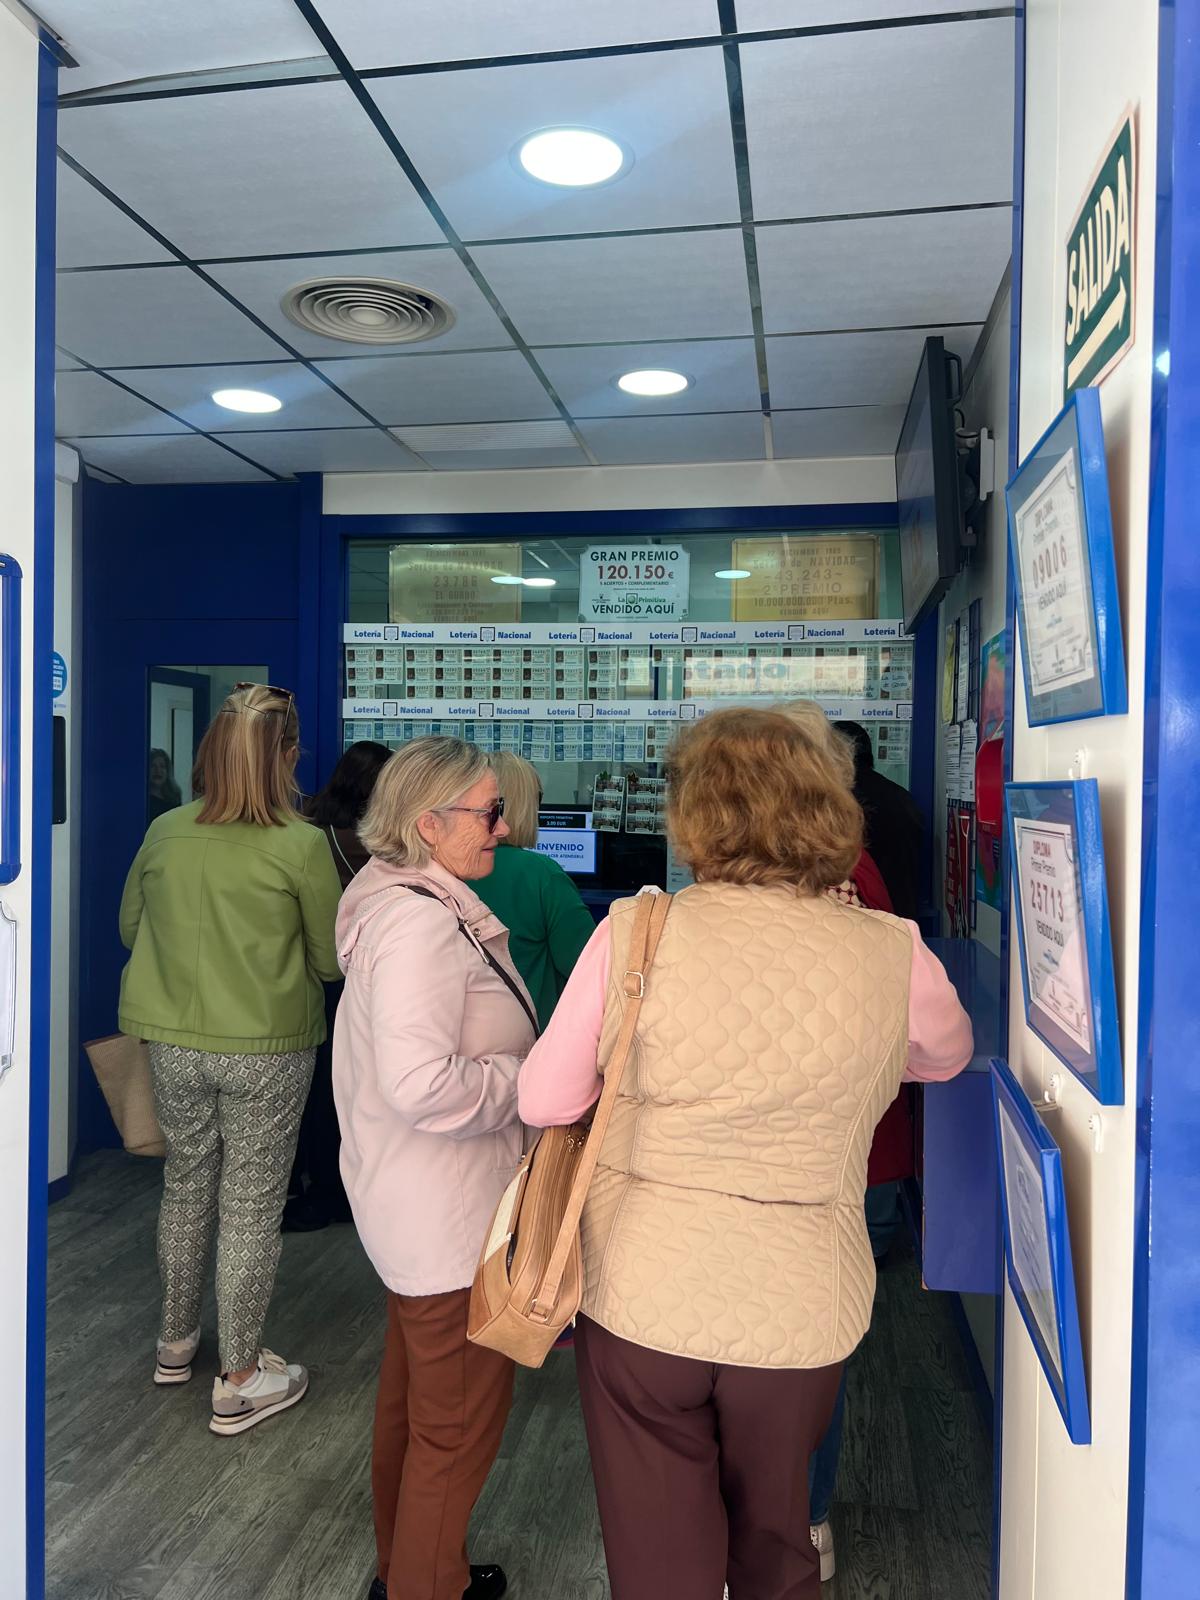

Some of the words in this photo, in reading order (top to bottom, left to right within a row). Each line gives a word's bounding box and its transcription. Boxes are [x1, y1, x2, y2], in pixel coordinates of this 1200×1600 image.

[1066, 154, 1129, 346] SALIDA
[590, 551, 627, 561] GRAN
[632, 550, 679, 561] PREMIO
[592, 605, 642, 614] VENDIDO
[646, 602, 675, 614] AQUÍ
[354, 630, 381, 639] Lotería
[401, 630, 434, 639] Nacional
[450, 630, 478, 639] Lotería
[498, 630, 532, 639] Nacional
[548, 631, 577, 640] Lotería
[597, 632, 633, 641] Nacional
[649, 631, 679, 640] Lotería
[700, 631, 736, 640] Nacional
[754, 630, 785, 639] Lotería
[807, 628, 845, 638] Nacional
[864, 628, 896, 637] Lotería
[353, 706, 381, 714] Lotería
[448, 706, 476, 715] Lotería
[548, 708, 576, 716] Lotería
[596, 708, 631, 716] Nacional
[648, 708, 677, 716] Lotería
[862, 708, 894, 716] Lotería
[536, 843, 584, 852] ENVENIDO
[1030, 880, 1064, 923] 25713
